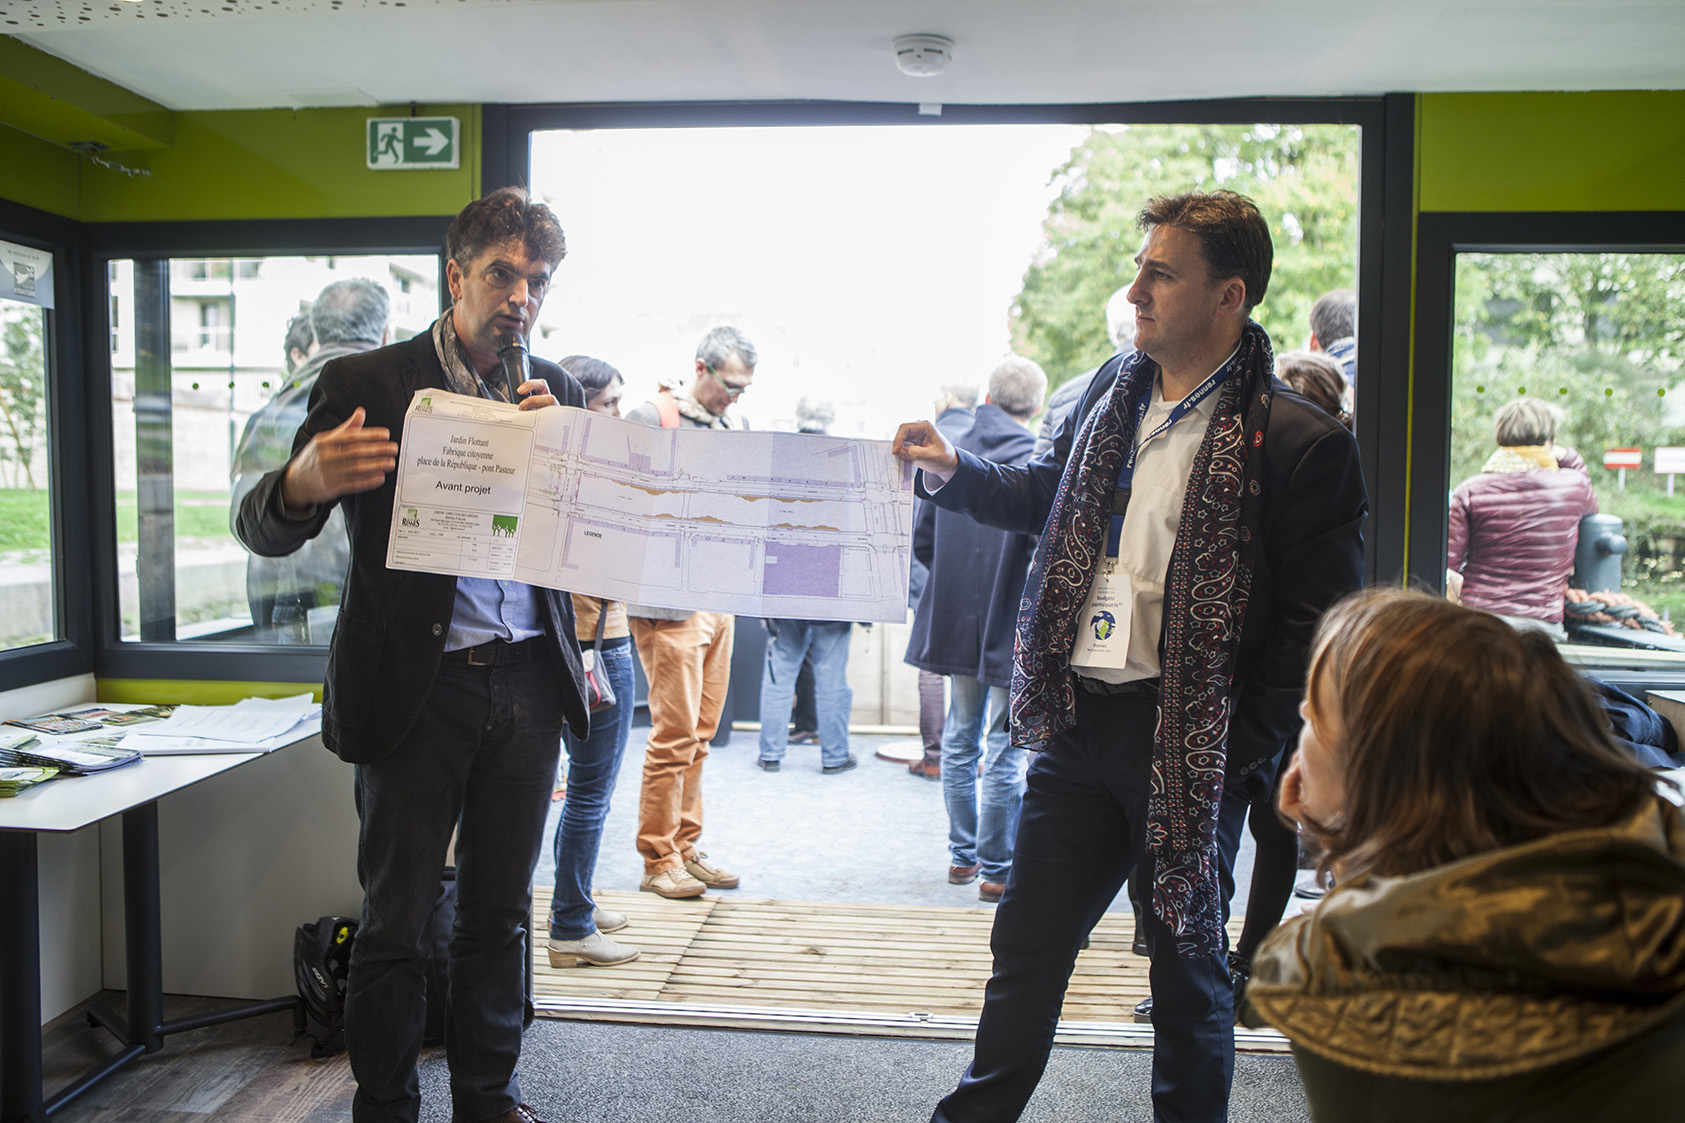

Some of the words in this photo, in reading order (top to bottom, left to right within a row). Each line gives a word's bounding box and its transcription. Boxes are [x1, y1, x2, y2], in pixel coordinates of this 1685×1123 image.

[1183, 379, 1216, 410] rennes.fr
[450, 435, 467, 445] Jardin
[468, 437, 489, 447] Flottant
[443, 446, 466, 458] Fabrique
[467, 451, 493, 461] citoyenne
[417, 457, 432, 467] place
[432, 458, 440, 467] de
[440, 459, 446, 467] la
[447, 460, 477, 471] République
[482, 464, 494, 473] pont
[495, 465, 515, 474] Pasteur
[436, 481, 463, 491] Avant
[465, 484, 491, 495] projet
